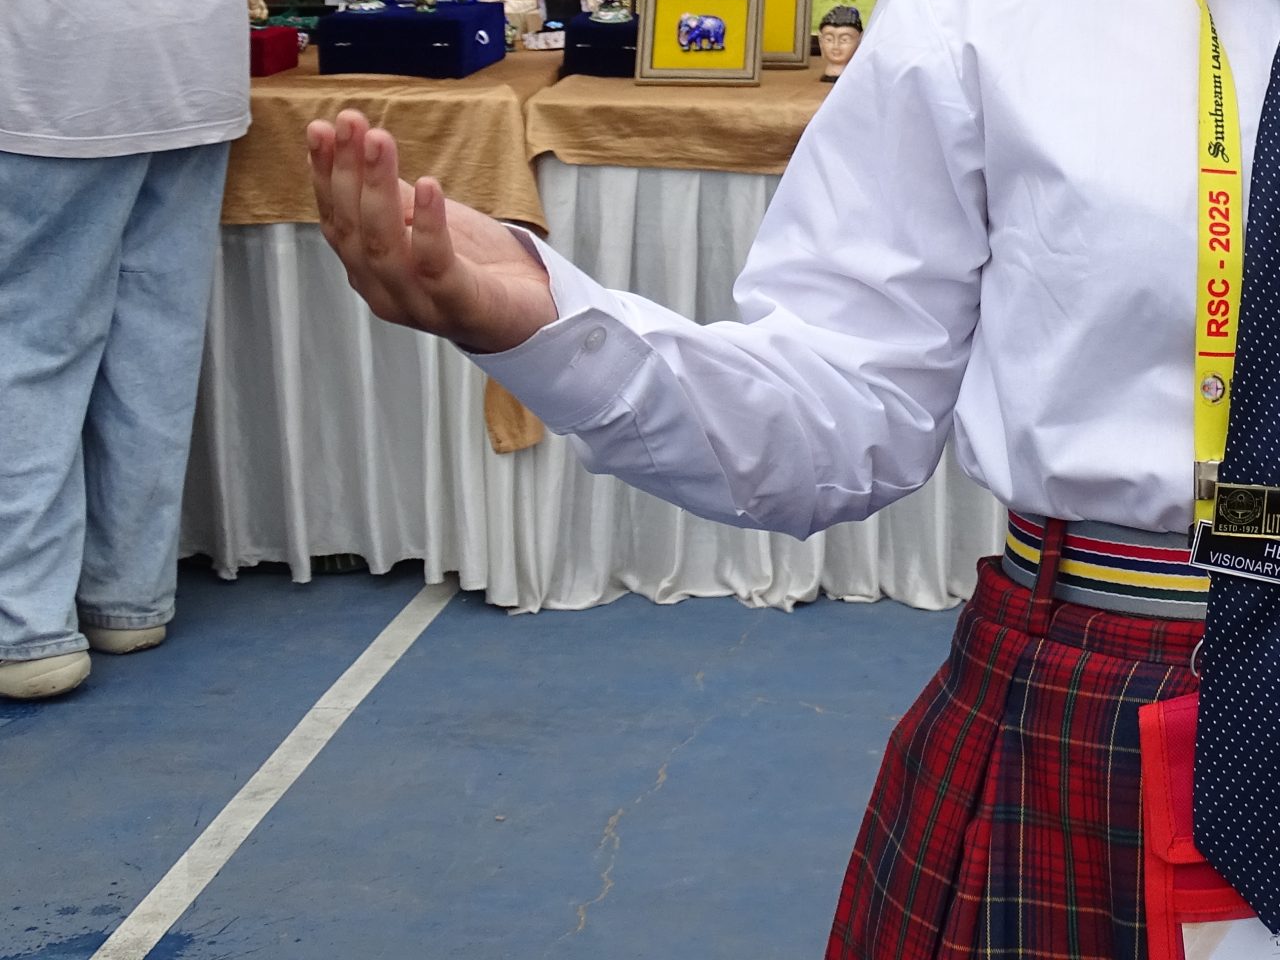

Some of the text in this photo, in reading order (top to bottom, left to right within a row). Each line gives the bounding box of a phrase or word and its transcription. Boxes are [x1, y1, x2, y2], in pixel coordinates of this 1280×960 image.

[1208, 74, 1230, 163] Sunbeam
[1207, 190, 1231, 338] RSC 2025
